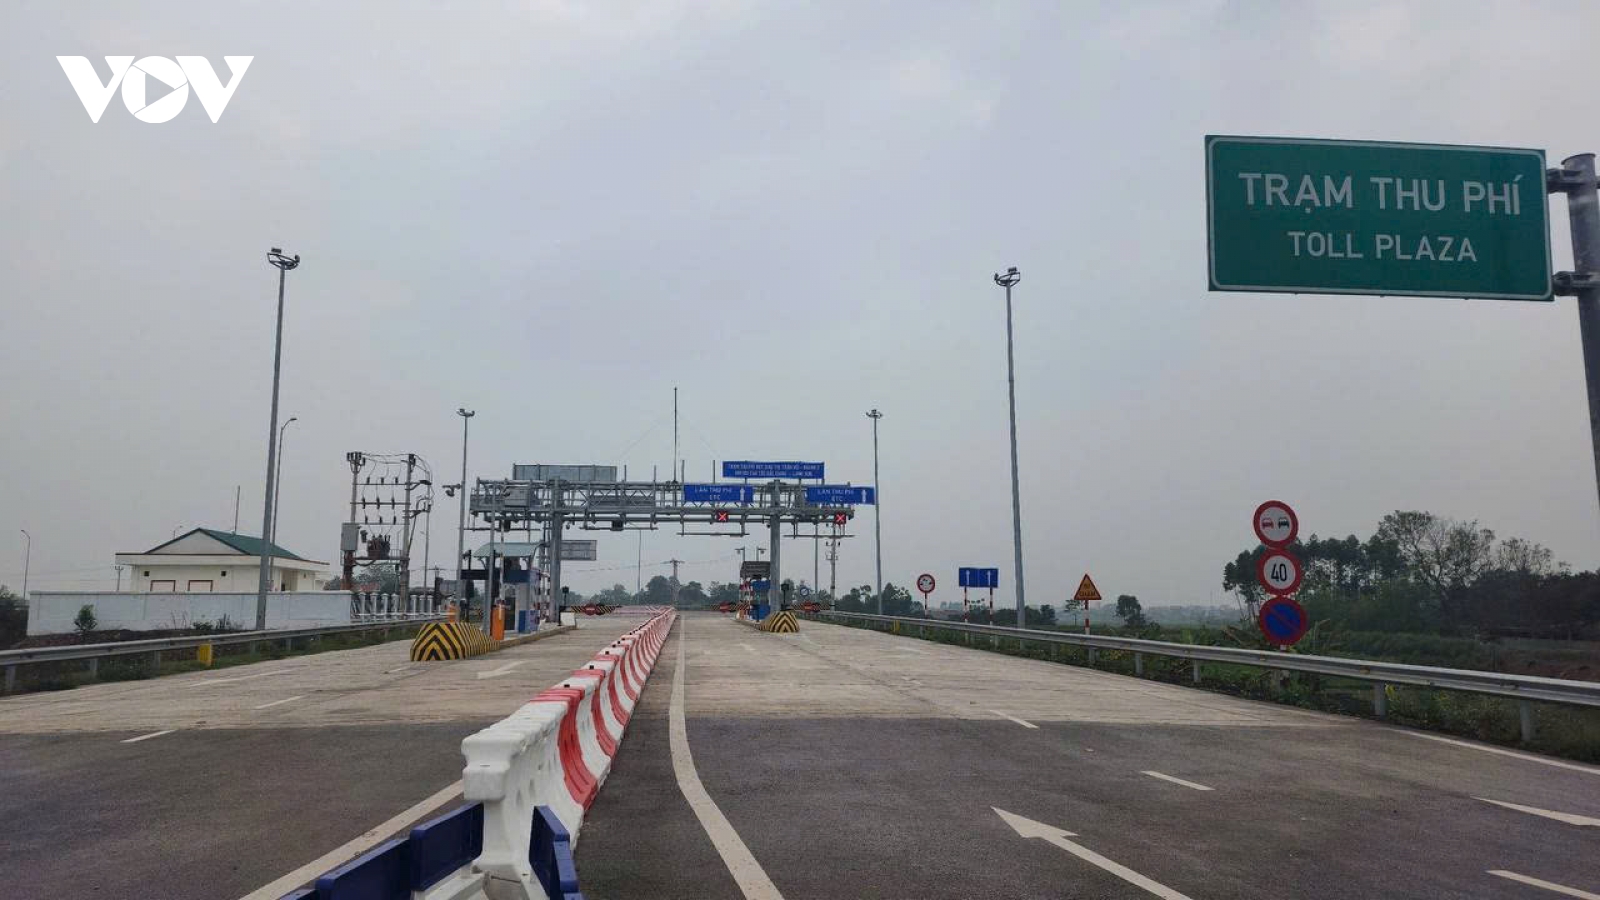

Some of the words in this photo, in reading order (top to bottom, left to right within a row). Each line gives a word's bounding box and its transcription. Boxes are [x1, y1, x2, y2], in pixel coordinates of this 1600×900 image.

[1238, 172, 1352, 213] TRẠM
[1370, 176, 1446, 211] THU
[1463, 174, 1523, 215] PHÍ
[1287, 231, 1364, 258] TOLL
[1375, 234, 1477, 262] PLAZA
[1271, 563, 1287, 582] 40
